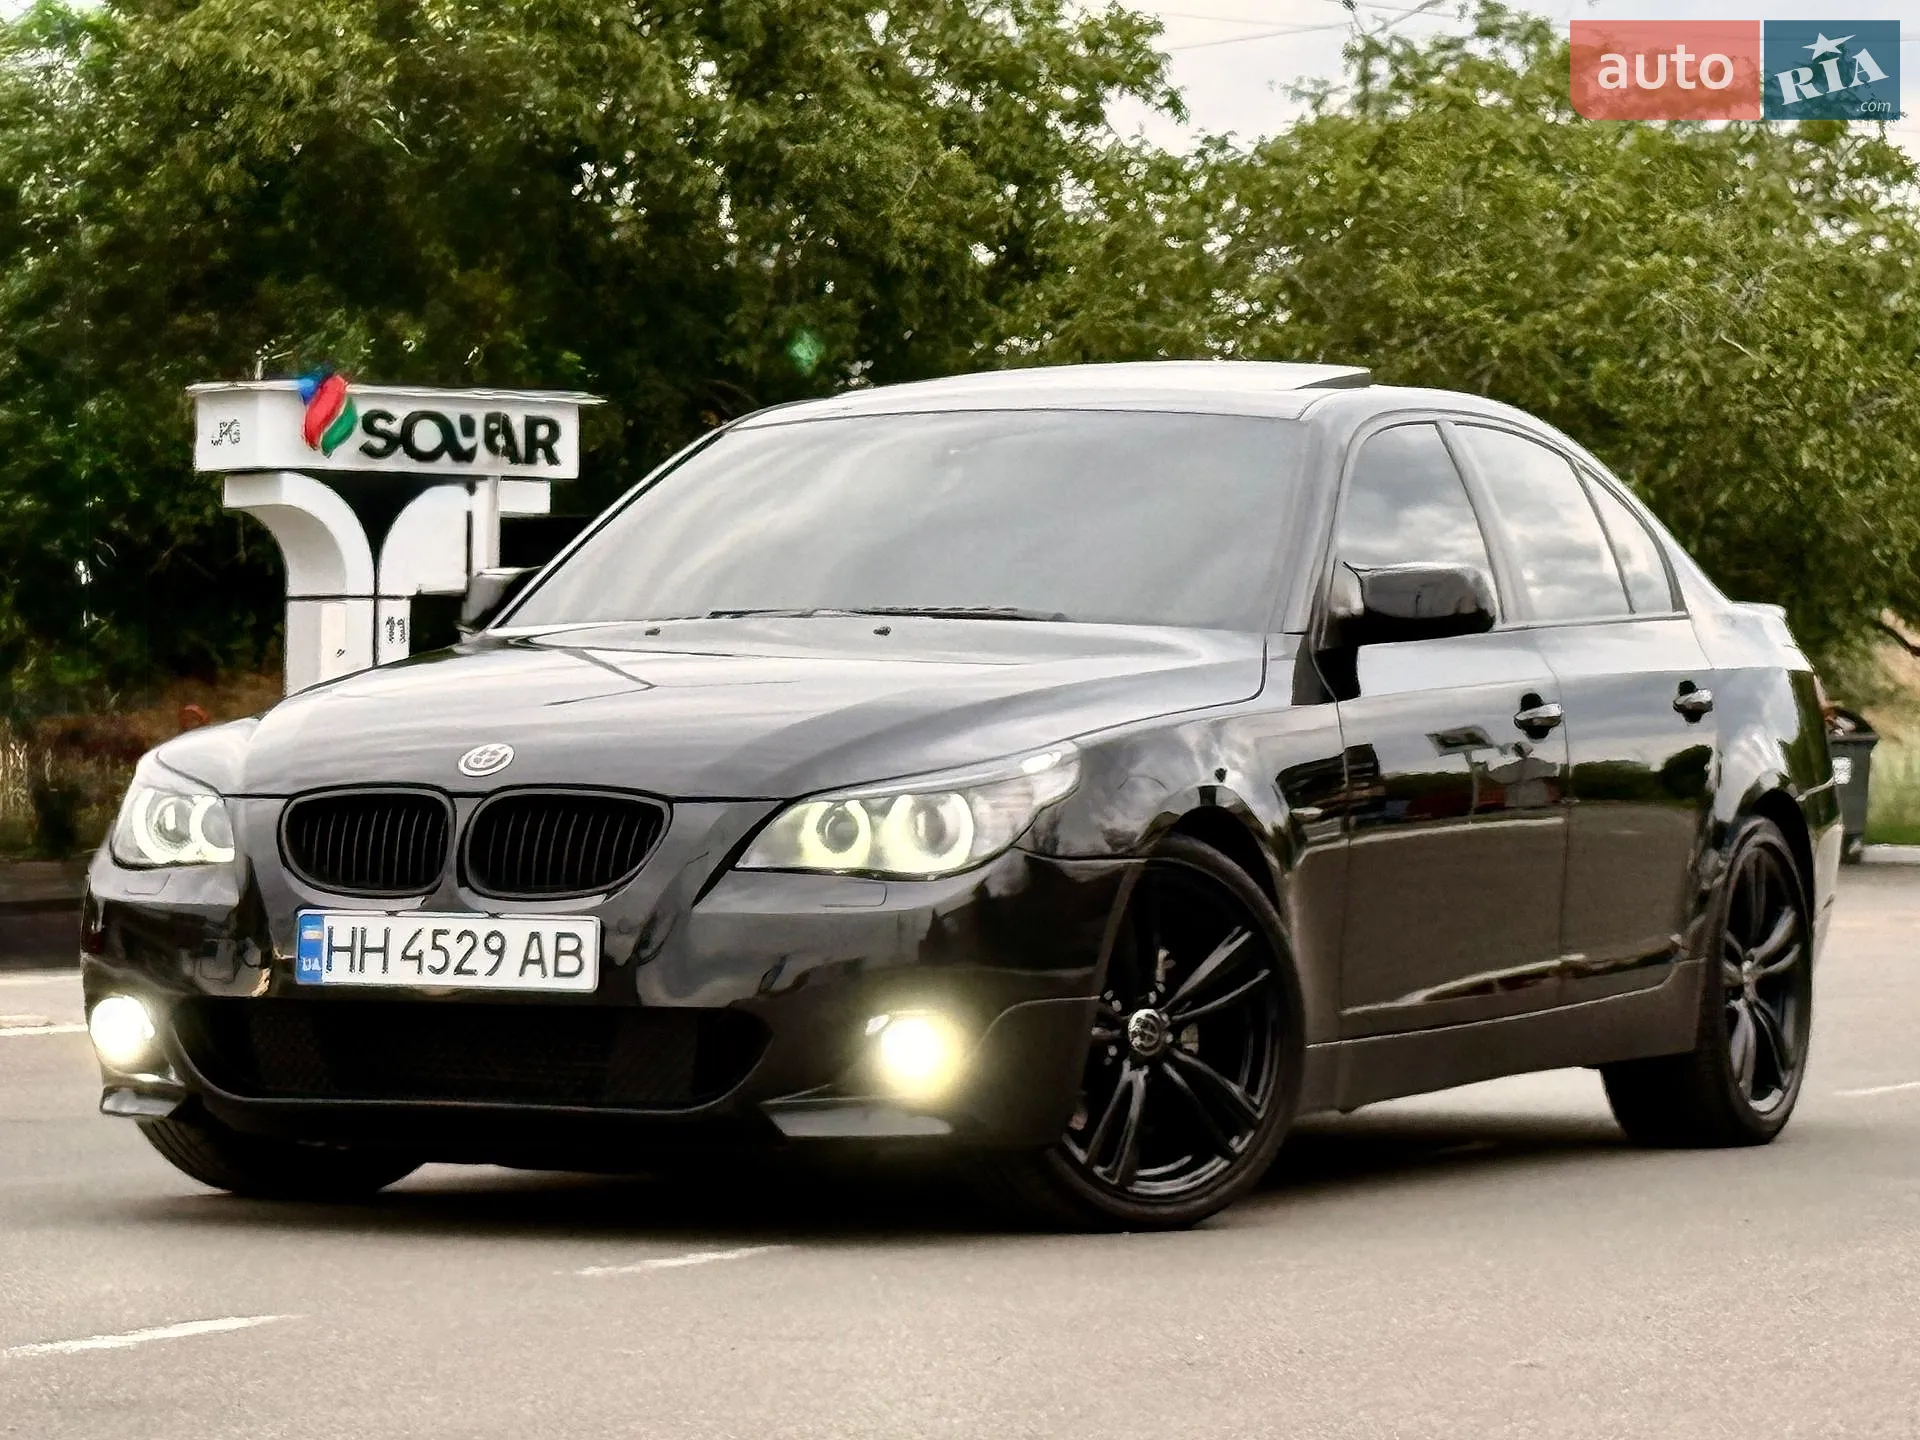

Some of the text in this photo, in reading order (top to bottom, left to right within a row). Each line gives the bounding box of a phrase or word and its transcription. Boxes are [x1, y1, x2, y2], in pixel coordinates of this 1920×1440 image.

[302, 957, 322, 971] UA
[325, 926, 585, 978] HH 4529 AB
